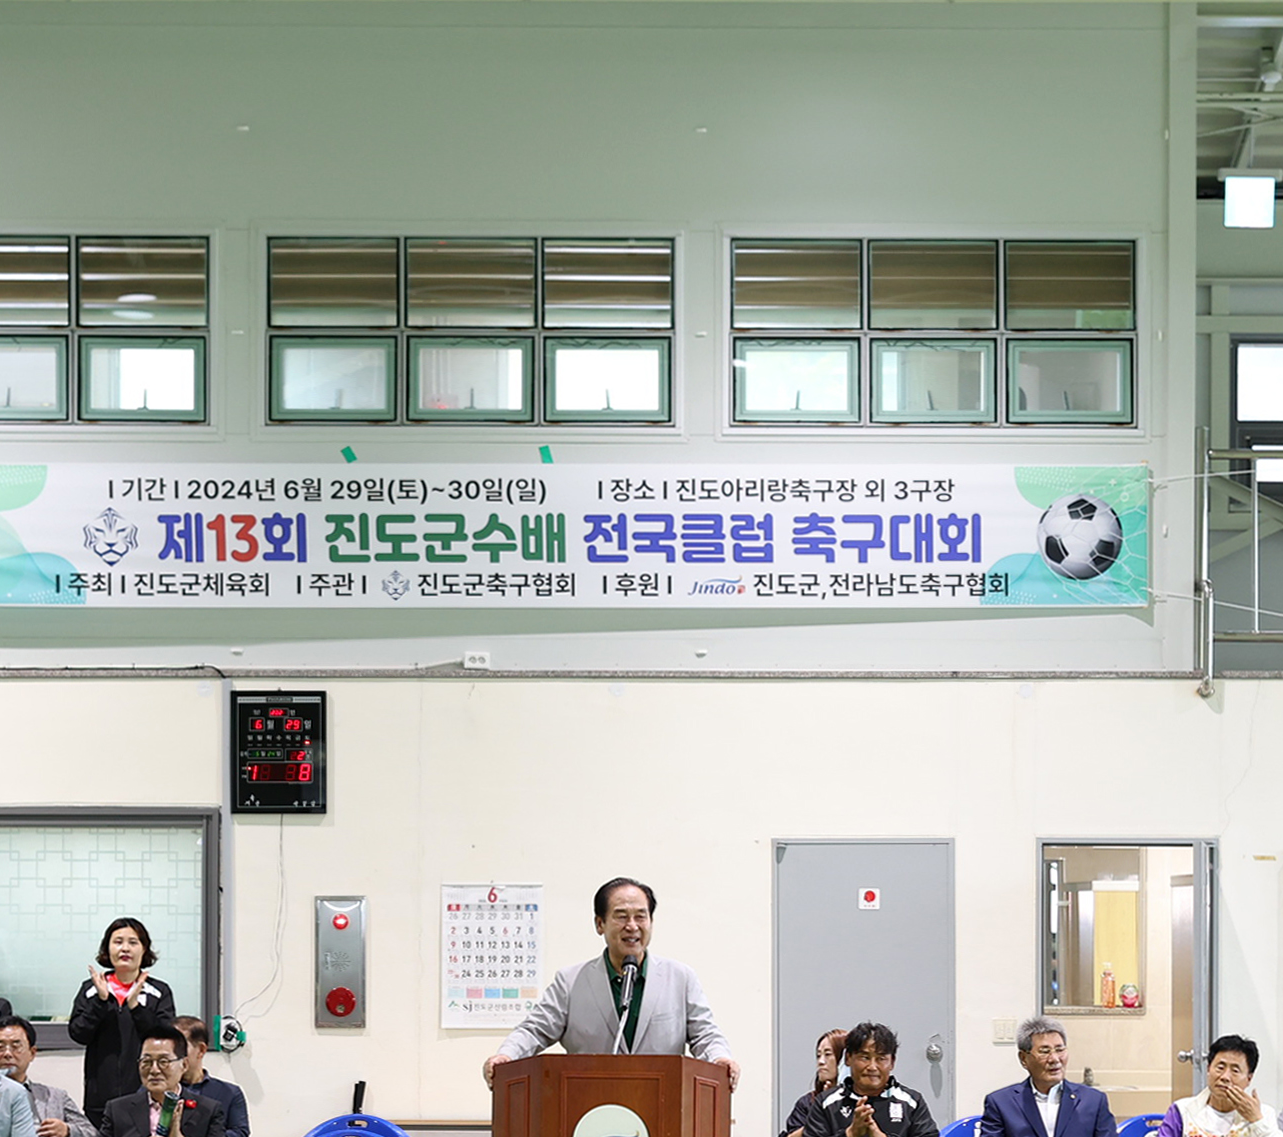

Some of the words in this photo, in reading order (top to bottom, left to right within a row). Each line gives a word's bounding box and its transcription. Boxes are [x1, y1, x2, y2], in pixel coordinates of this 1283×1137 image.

[122, 478, 167, 502] 기간
[187, 478, 276, 502] 2024년
[283, 478, 323, 503] 6월
[331, 478, 547, 506] 29일(토)~30일(일)
[610, 479, 656, 503] 장소
[676, 479, 858, 503] 진도아리랑축구장
[865, 479, 885, 503] 외
[894, 479, 955, 503] 3구장
[157, 512, 308, 564] 제13회
[324, 512, 567, 564] 진도군수배
[583, 512, 774, 563] 전국클럽
[791, 512, 982, 564] 축구대회
[67, 573, 112, 597] 주최
[134, 573, 269, 597] 진도군체육회
[309, 573, 355, 597] 주관
[418, 573, 576, 597] 진도군축구협회
[615, 573, 659, 597] 후원
[687, 580, 736, 596] Jindo
[753, 573, 1010, 600] 진도군,전라남도축구협회
[255, 720, 263, 730] 6
[285, 720, 300, 730] 29
[487, 886, 498, 903] 6
[451, 926, 456, 934] 2
[464, 926, 469, 934] 3
[477, 926, 482, 934] 4
[490, 926, 495, 934] 5
[503, 926, 508, 934] 6
[516, 926, 521, 934] 7
[451, 941, 456, 949] 9
[462, 941, 471, 949] 10
[475, 941, 484, 949] 11
[488, 941, 497, 949] 12
[501, 941, 510, 949] 13
[514, 941, 523, 949] 14
[527, 941, 536, 949] 15
[449, 955, 458, 963] 16
[462, 955, 471, 963] 17
[475, 955, 484, 963] 18
[488, 955, 497, 963] 19
[501, 955, 510, 963] 20
[514, 955, 523, 963] 21
[462, 970, 471, 978] 24
[475, 970, 484, 978] 25
[488, 970, 497, 978] 26
[501, 970, 510, 978] 27
[514, 970, 523, 978] 28
